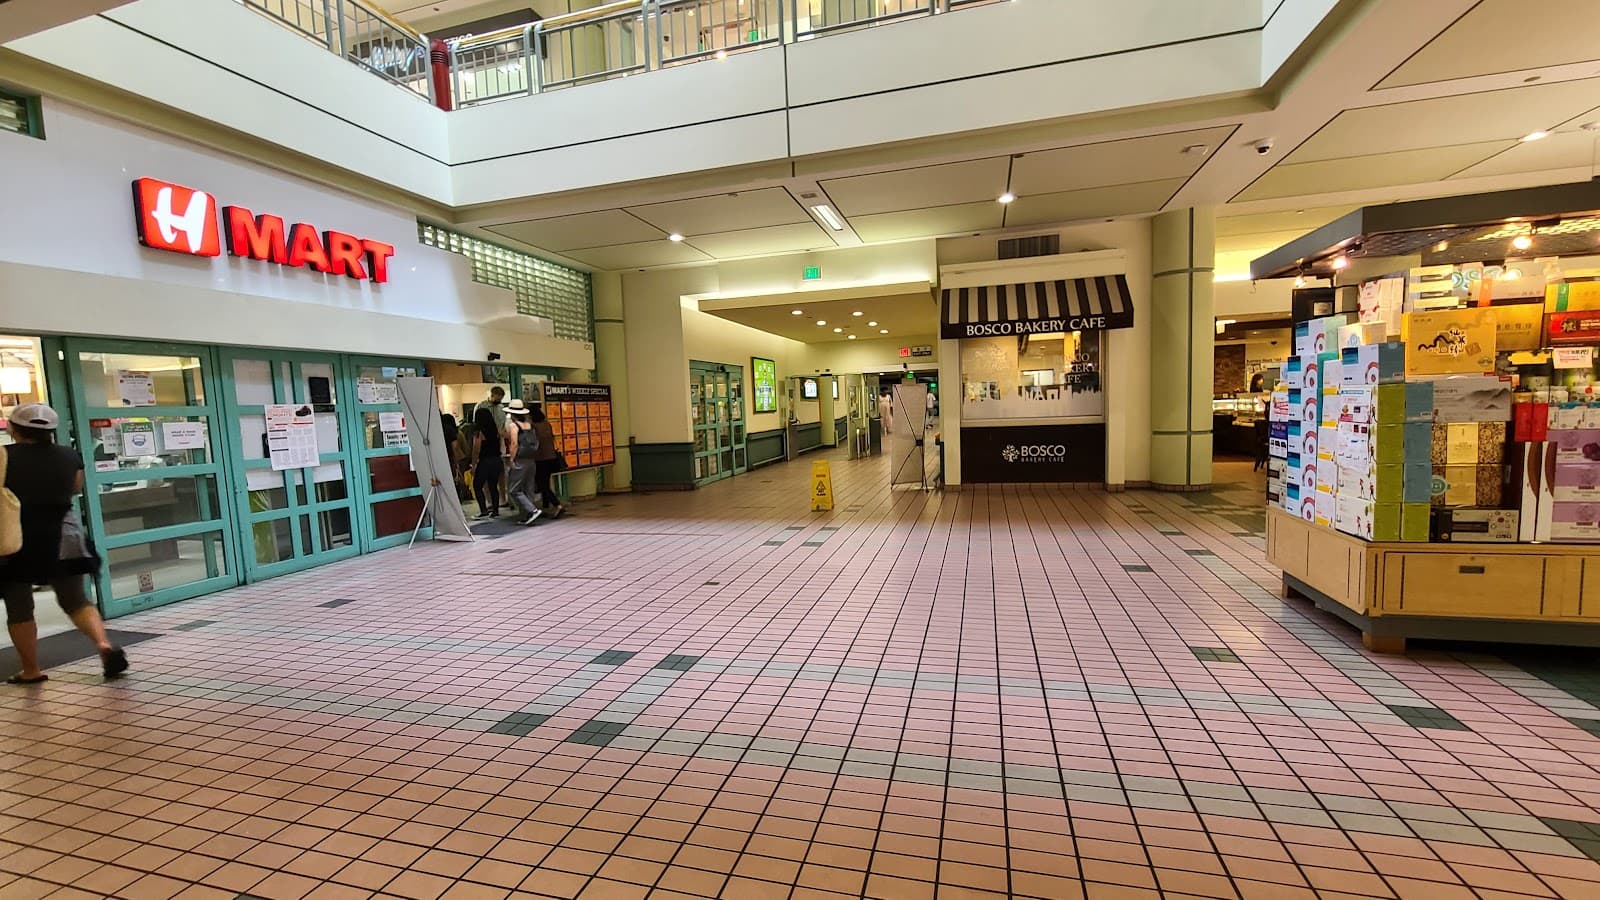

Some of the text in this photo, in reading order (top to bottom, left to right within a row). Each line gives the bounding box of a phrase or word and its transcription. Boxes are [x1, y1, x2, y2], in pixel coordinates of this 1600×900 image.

[222, 205, 394, 283] MART
[966, 317, 1106, 336] BOSCO BAKERY CAFE
[1021, 445, 1066, 457] BOSCO
